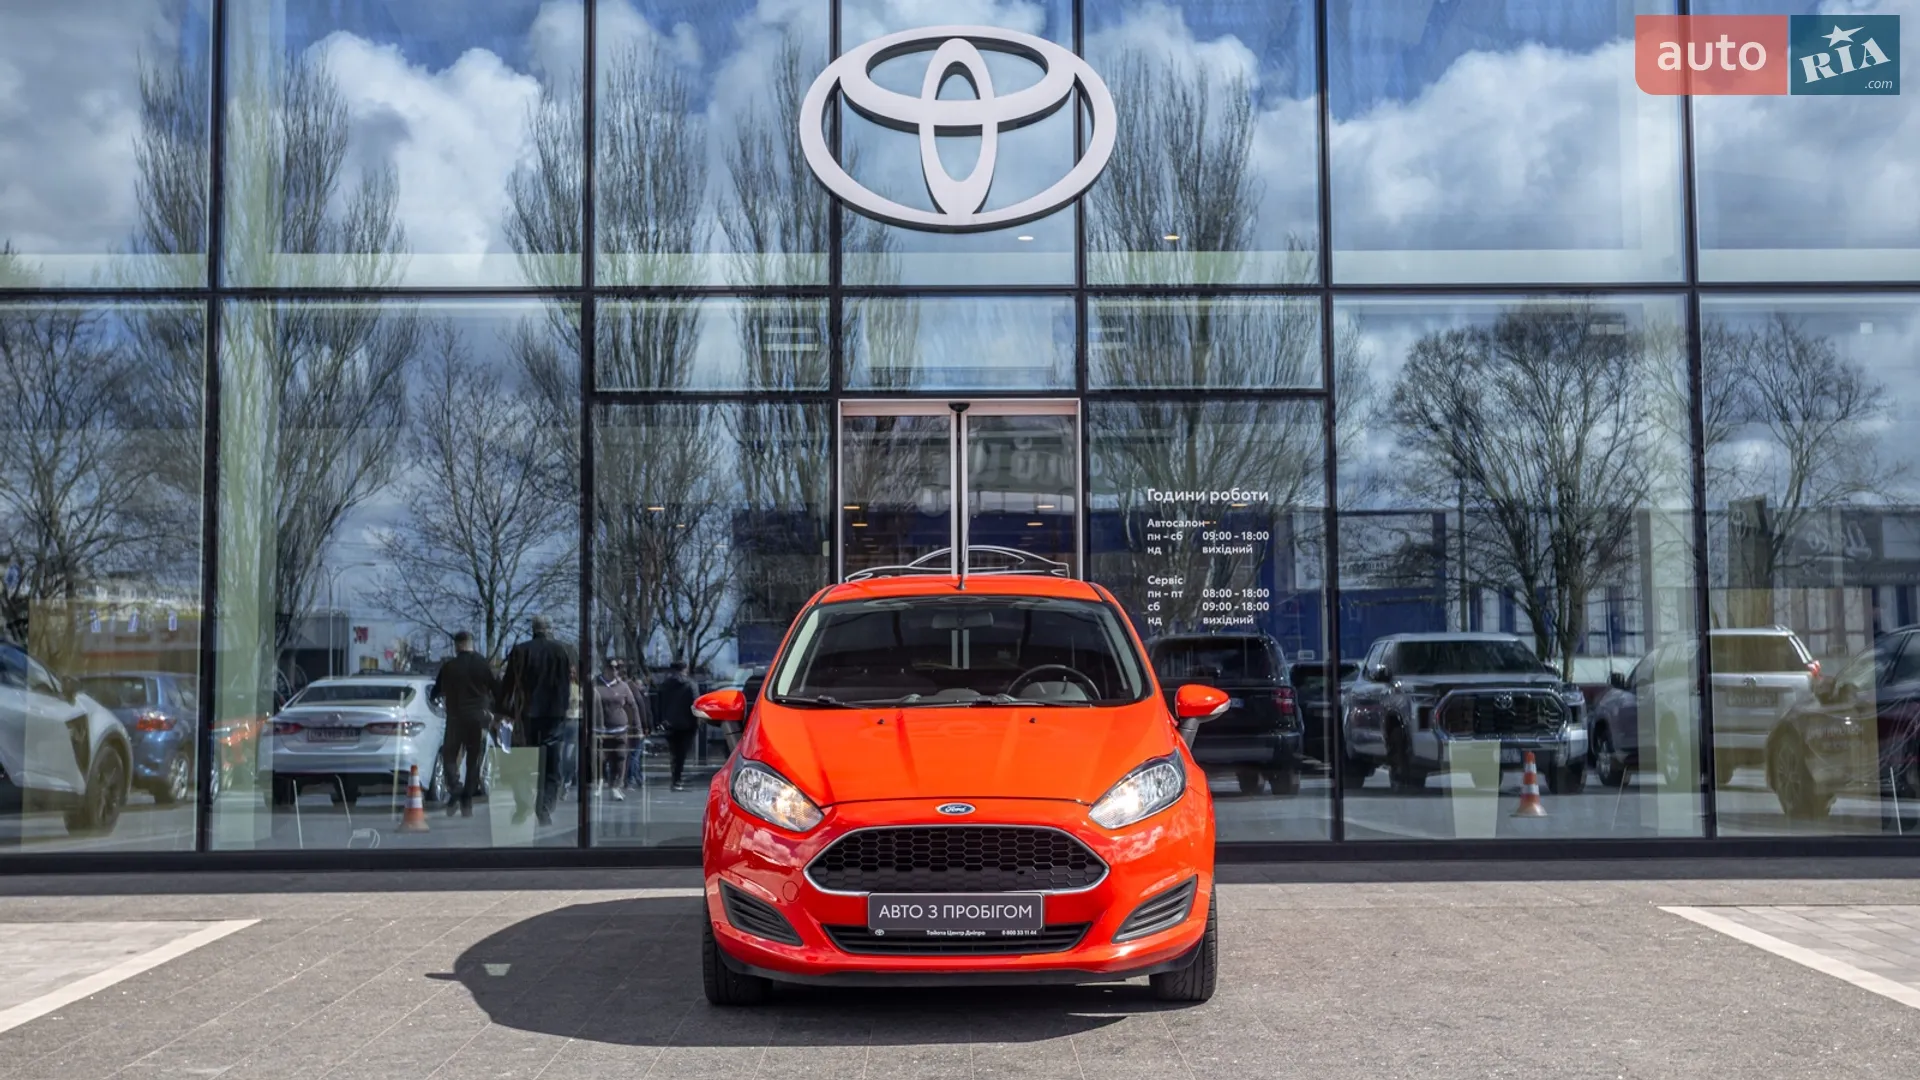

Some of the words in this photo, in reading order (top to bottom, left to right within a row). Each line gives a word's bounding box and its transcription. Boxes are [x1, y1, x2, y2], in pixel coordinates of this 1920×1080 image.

[1147, 488, 1205, 504] Години
[1210, 488, 1269, 504] роботи
[1147, 518, 1205, 528] Автосалон
[1147, 533, 1161, 541] пн
[1171, 531, 1183, 541] сб
[1202, 531, 1232, 541] 09:00
[1241, 531, 1269, 541] 18:00
[1147, 546, 1162, 555] нд
[1202, 544, 1253, 555] вихідний
[1147, 575, 1183, 587] Сервіс
[1147, 590, 1161, 598] пн
[1171, 590, 1183, 598] пт
[1202, 588, 1232, 598] 08:00
[1241, 588, 1269, 598] 18:00
[1147, 601, 1161, 611] сб
[1202, 602, 1232, 611] 09:00
[1241, 602, 1269, 611] 18:00
[1147, 616, 1162, 626] нд
[1202, 614, 1254, 626] вихідний
[945, 805, 967, 813] Ford
[878, 904, 923, 919] АВТО
[943, 904, 1032, 919] ПРОБІГОМ
